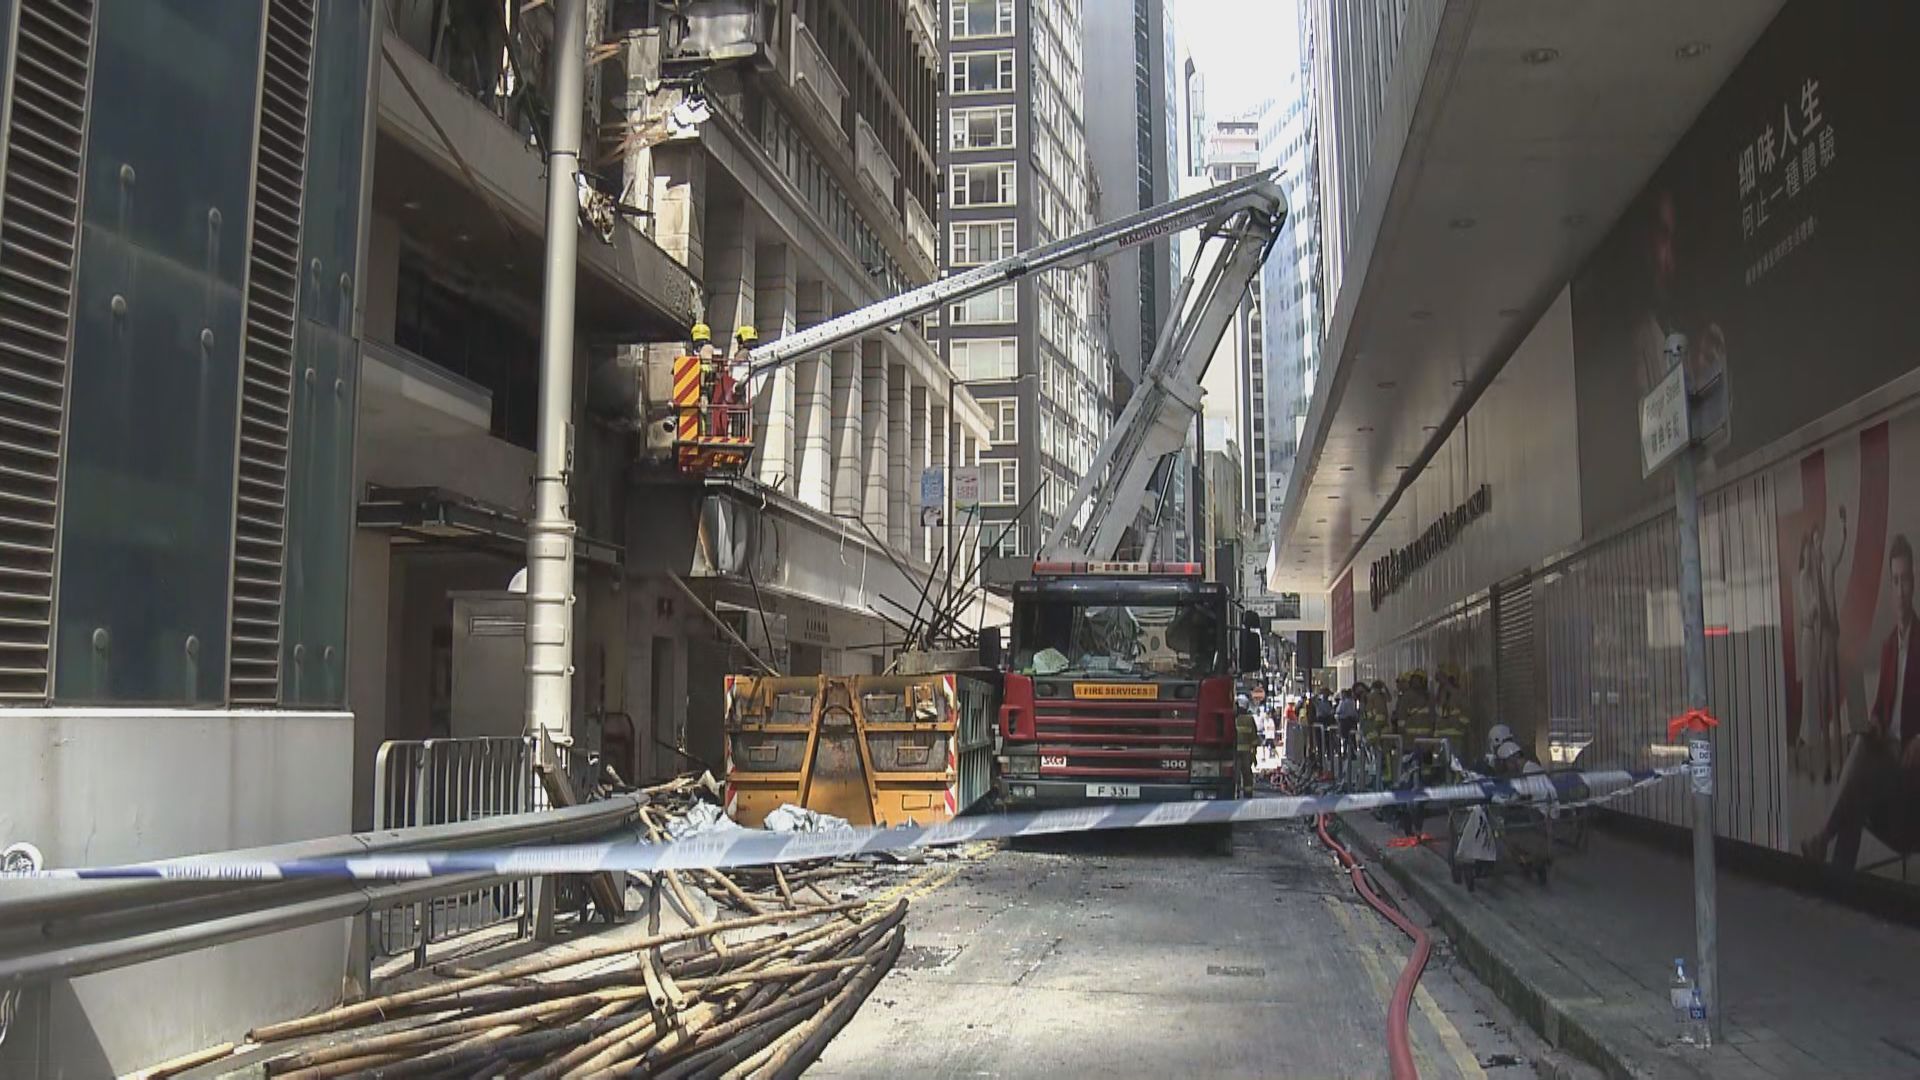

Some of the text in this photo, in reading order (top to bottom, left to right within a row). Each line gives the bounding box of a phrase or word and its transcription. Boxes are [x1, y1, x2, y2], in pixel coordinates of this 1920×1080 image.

[1738, 77, 1823, 200] 細味人生
[1741, 124, 1836, 241] 何止一種體驗
[1084, 687, 1104, 695] FIRE
[1105, 687, 1149, 695] SERVICES
[1161, 760, 1187, 768] 300
[1098, 785, 1105, 796] F
